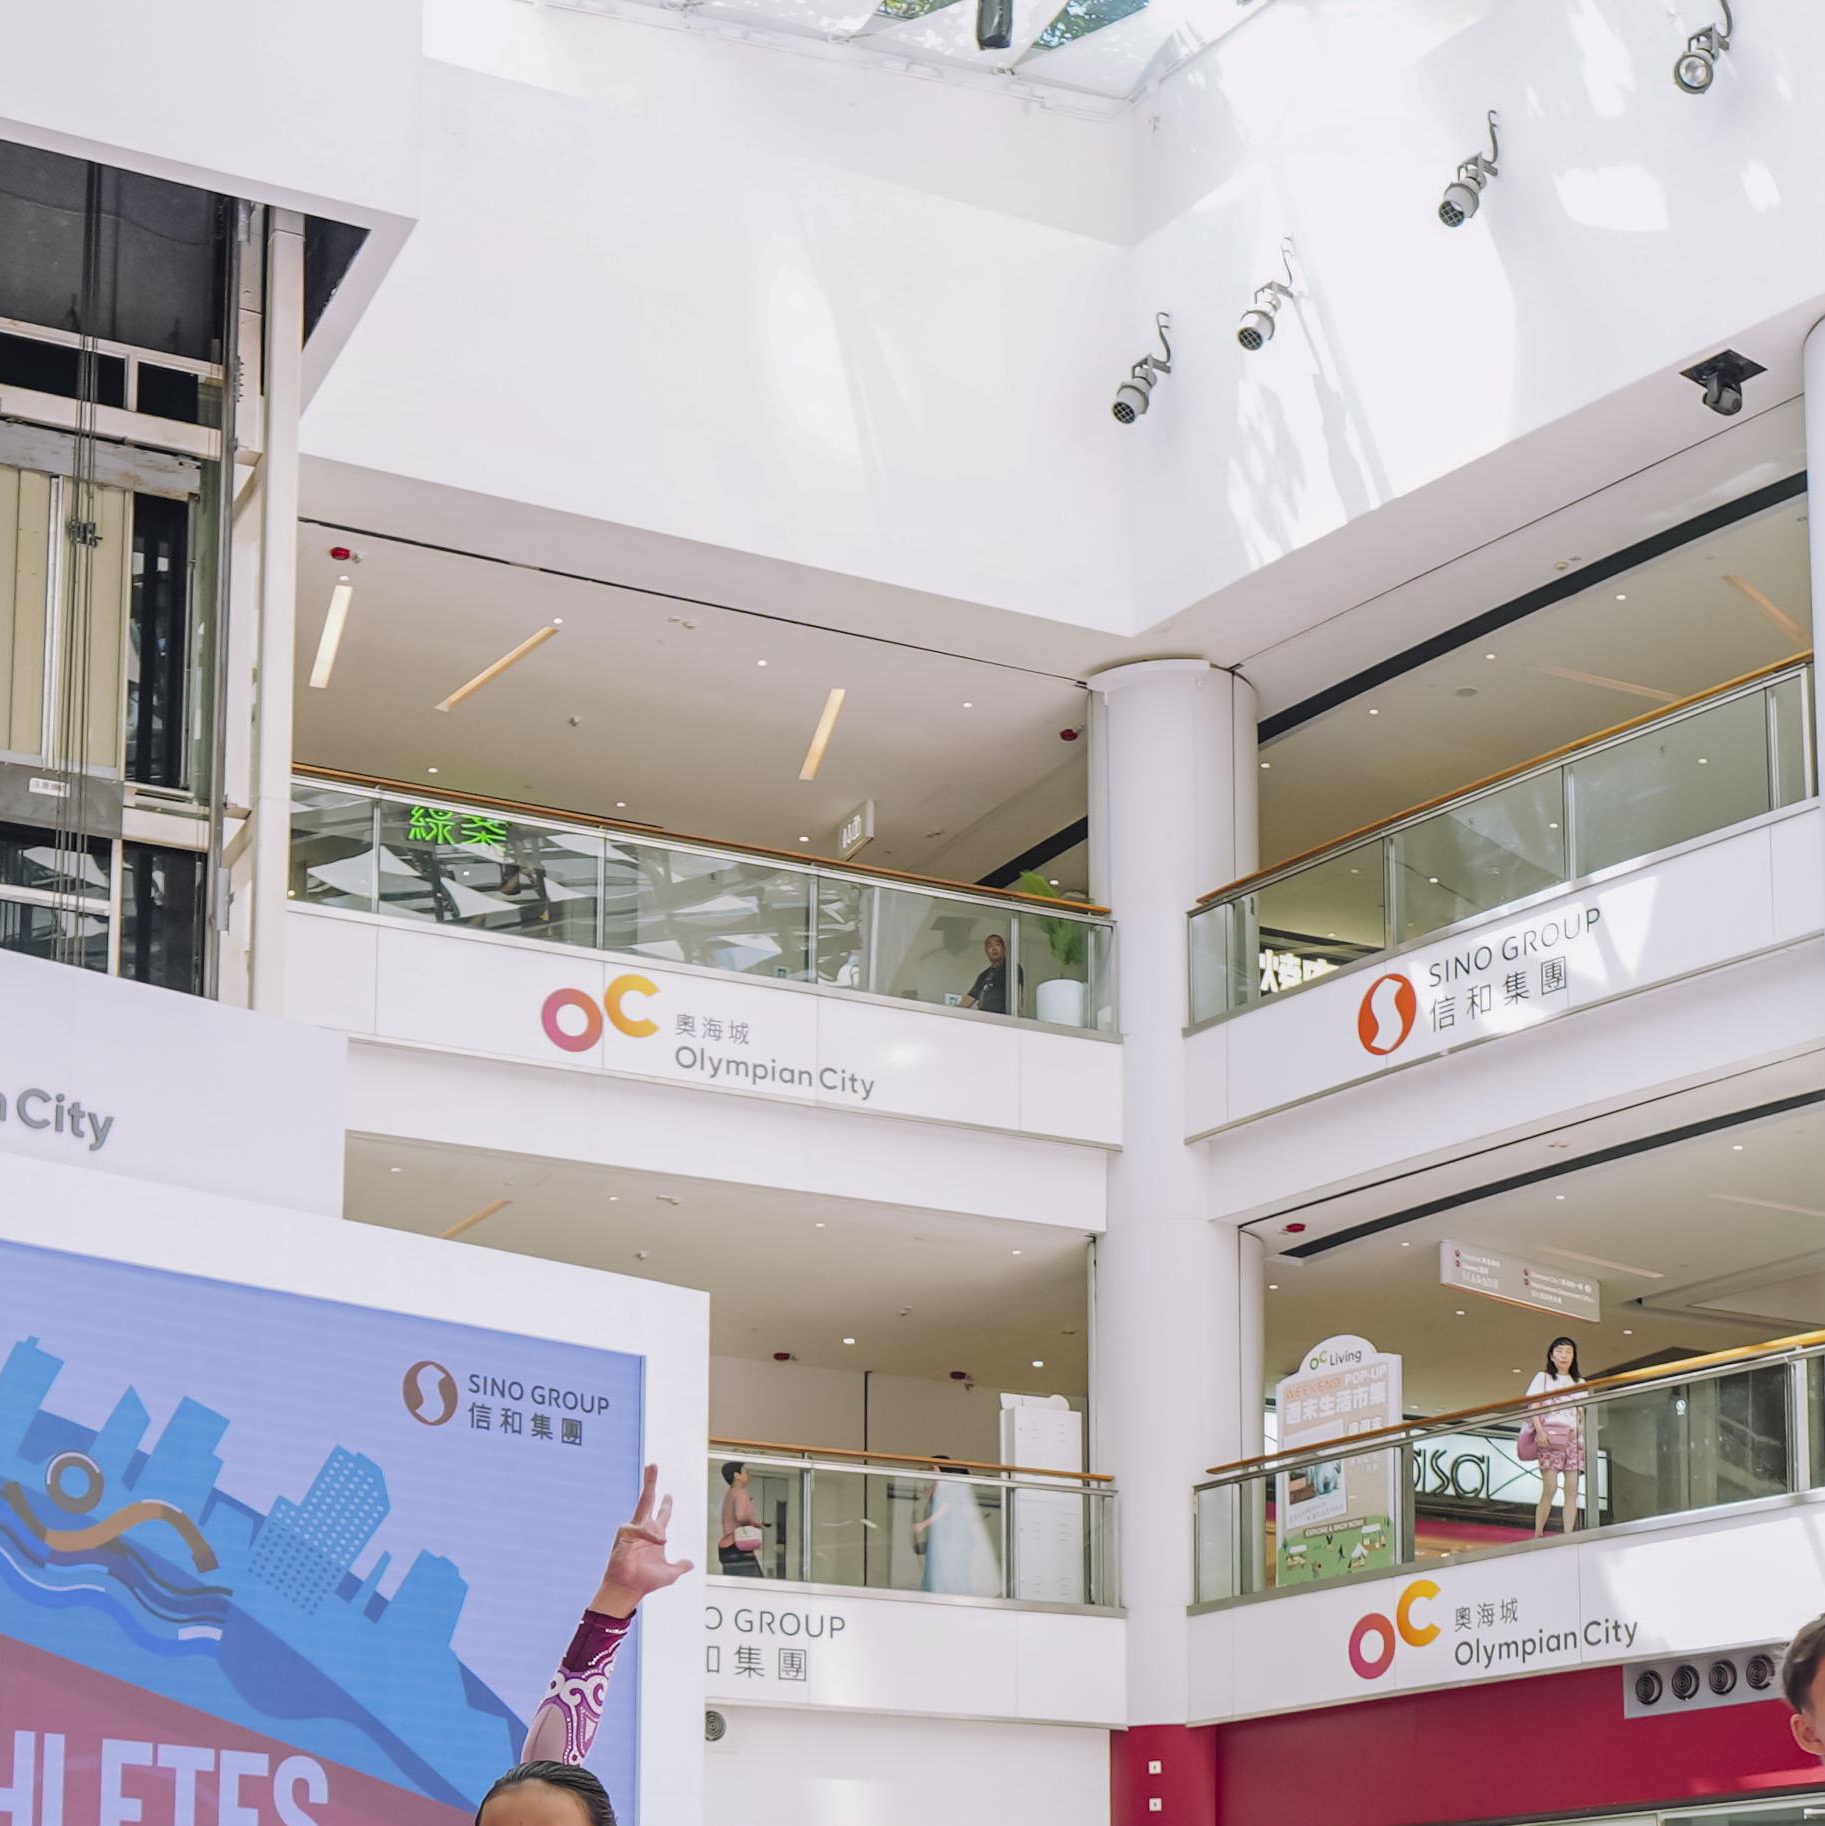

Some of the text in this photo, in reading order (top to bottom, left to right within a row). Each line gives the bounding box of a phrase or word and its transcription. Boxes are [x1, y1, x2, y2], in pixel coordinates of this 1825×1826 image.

[1429, 908, 1601, 987] SINO GROUP
[541, 974, 661, 1052] OC
[1430, 956, 1566, 1032] 信和集團
[675, 1046, 875, 1100] Olympian City
[16, 1088, 114, 1151] City
[1330, 1350, 1362, 1366] Living
[469, 1374, 609, 1415] SINO GROUP
[1285, 1376, 1342, 1399] WEEKEND
[468, 1402, 582, 1446] 信和集團
[734, 1608, 846, 1639] GROUP
[1348, 1579, 1441, 1680] OC
[1455, 1618, 1638, 1669] Olympian City
